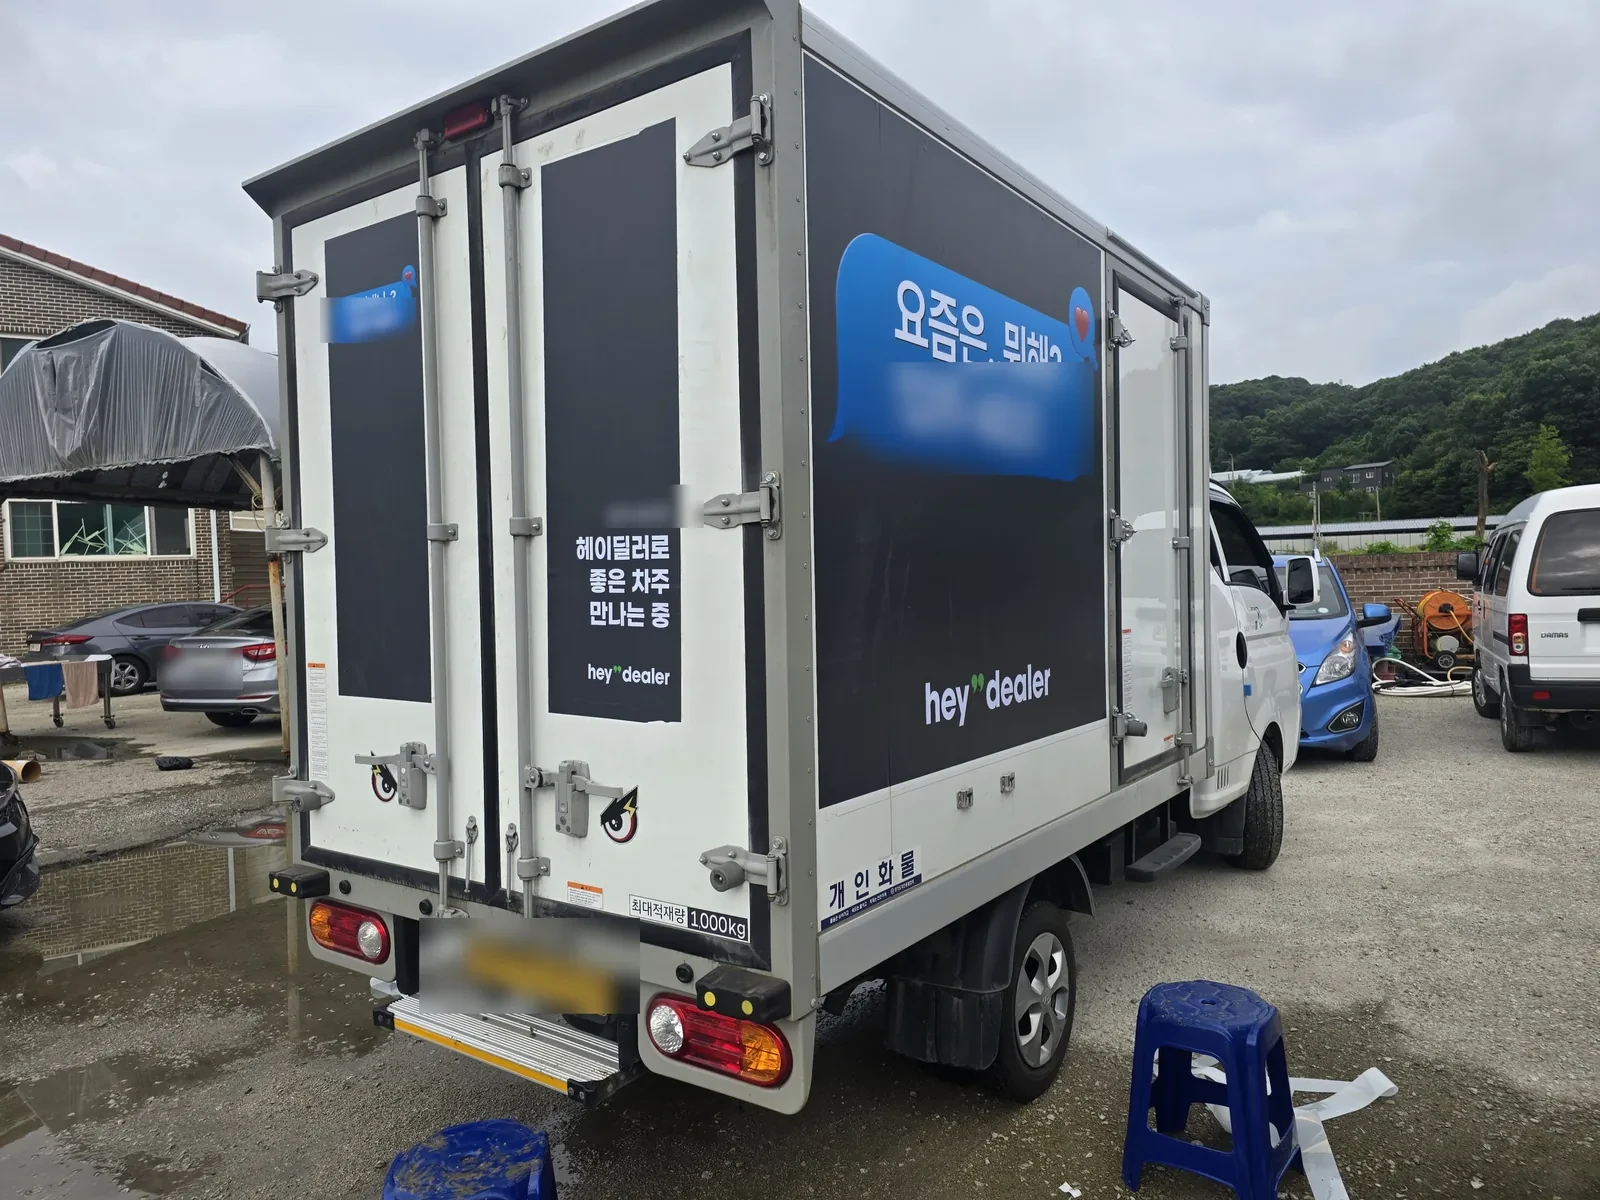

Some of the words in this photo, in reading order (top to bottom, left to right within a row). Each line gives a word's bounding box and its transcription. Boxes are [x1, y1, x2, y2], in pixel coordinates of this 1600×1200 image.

[576, 535, 670, 560] 헤이딜러로
[589, 568, 626, 594] 좋은
[631, 568, 670, 595] 차주
[589, 601, 645, 627] 만나는
[650, 602, 671, 628] 중
[631, 899, 686, 924] 최대적재량
